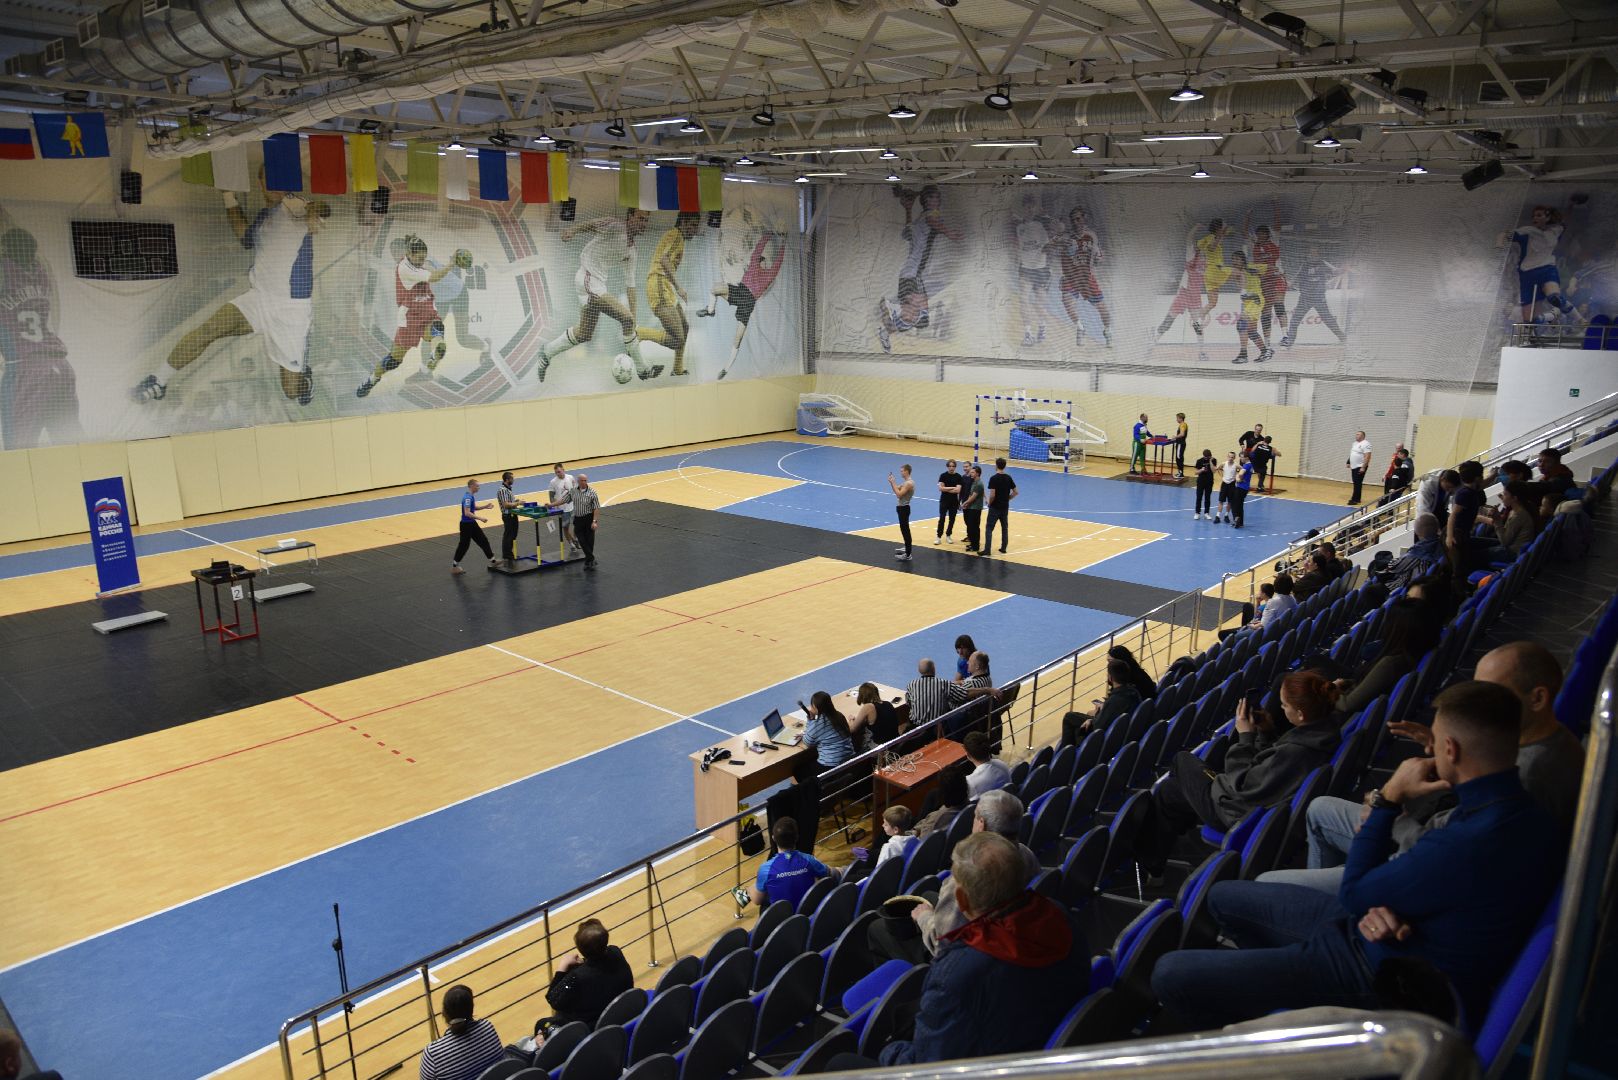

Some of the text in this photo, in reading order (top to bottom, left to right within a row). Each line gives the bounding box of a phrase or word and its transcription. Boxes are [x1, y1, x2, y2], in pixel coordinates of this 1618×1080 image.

[17, 311, 43, 342] 3
[99, 527, 124, 537] РОССИЯ
[233, 589, 241, 599] 2
[776, 867, 809, 879] ЛОТОШИНО
